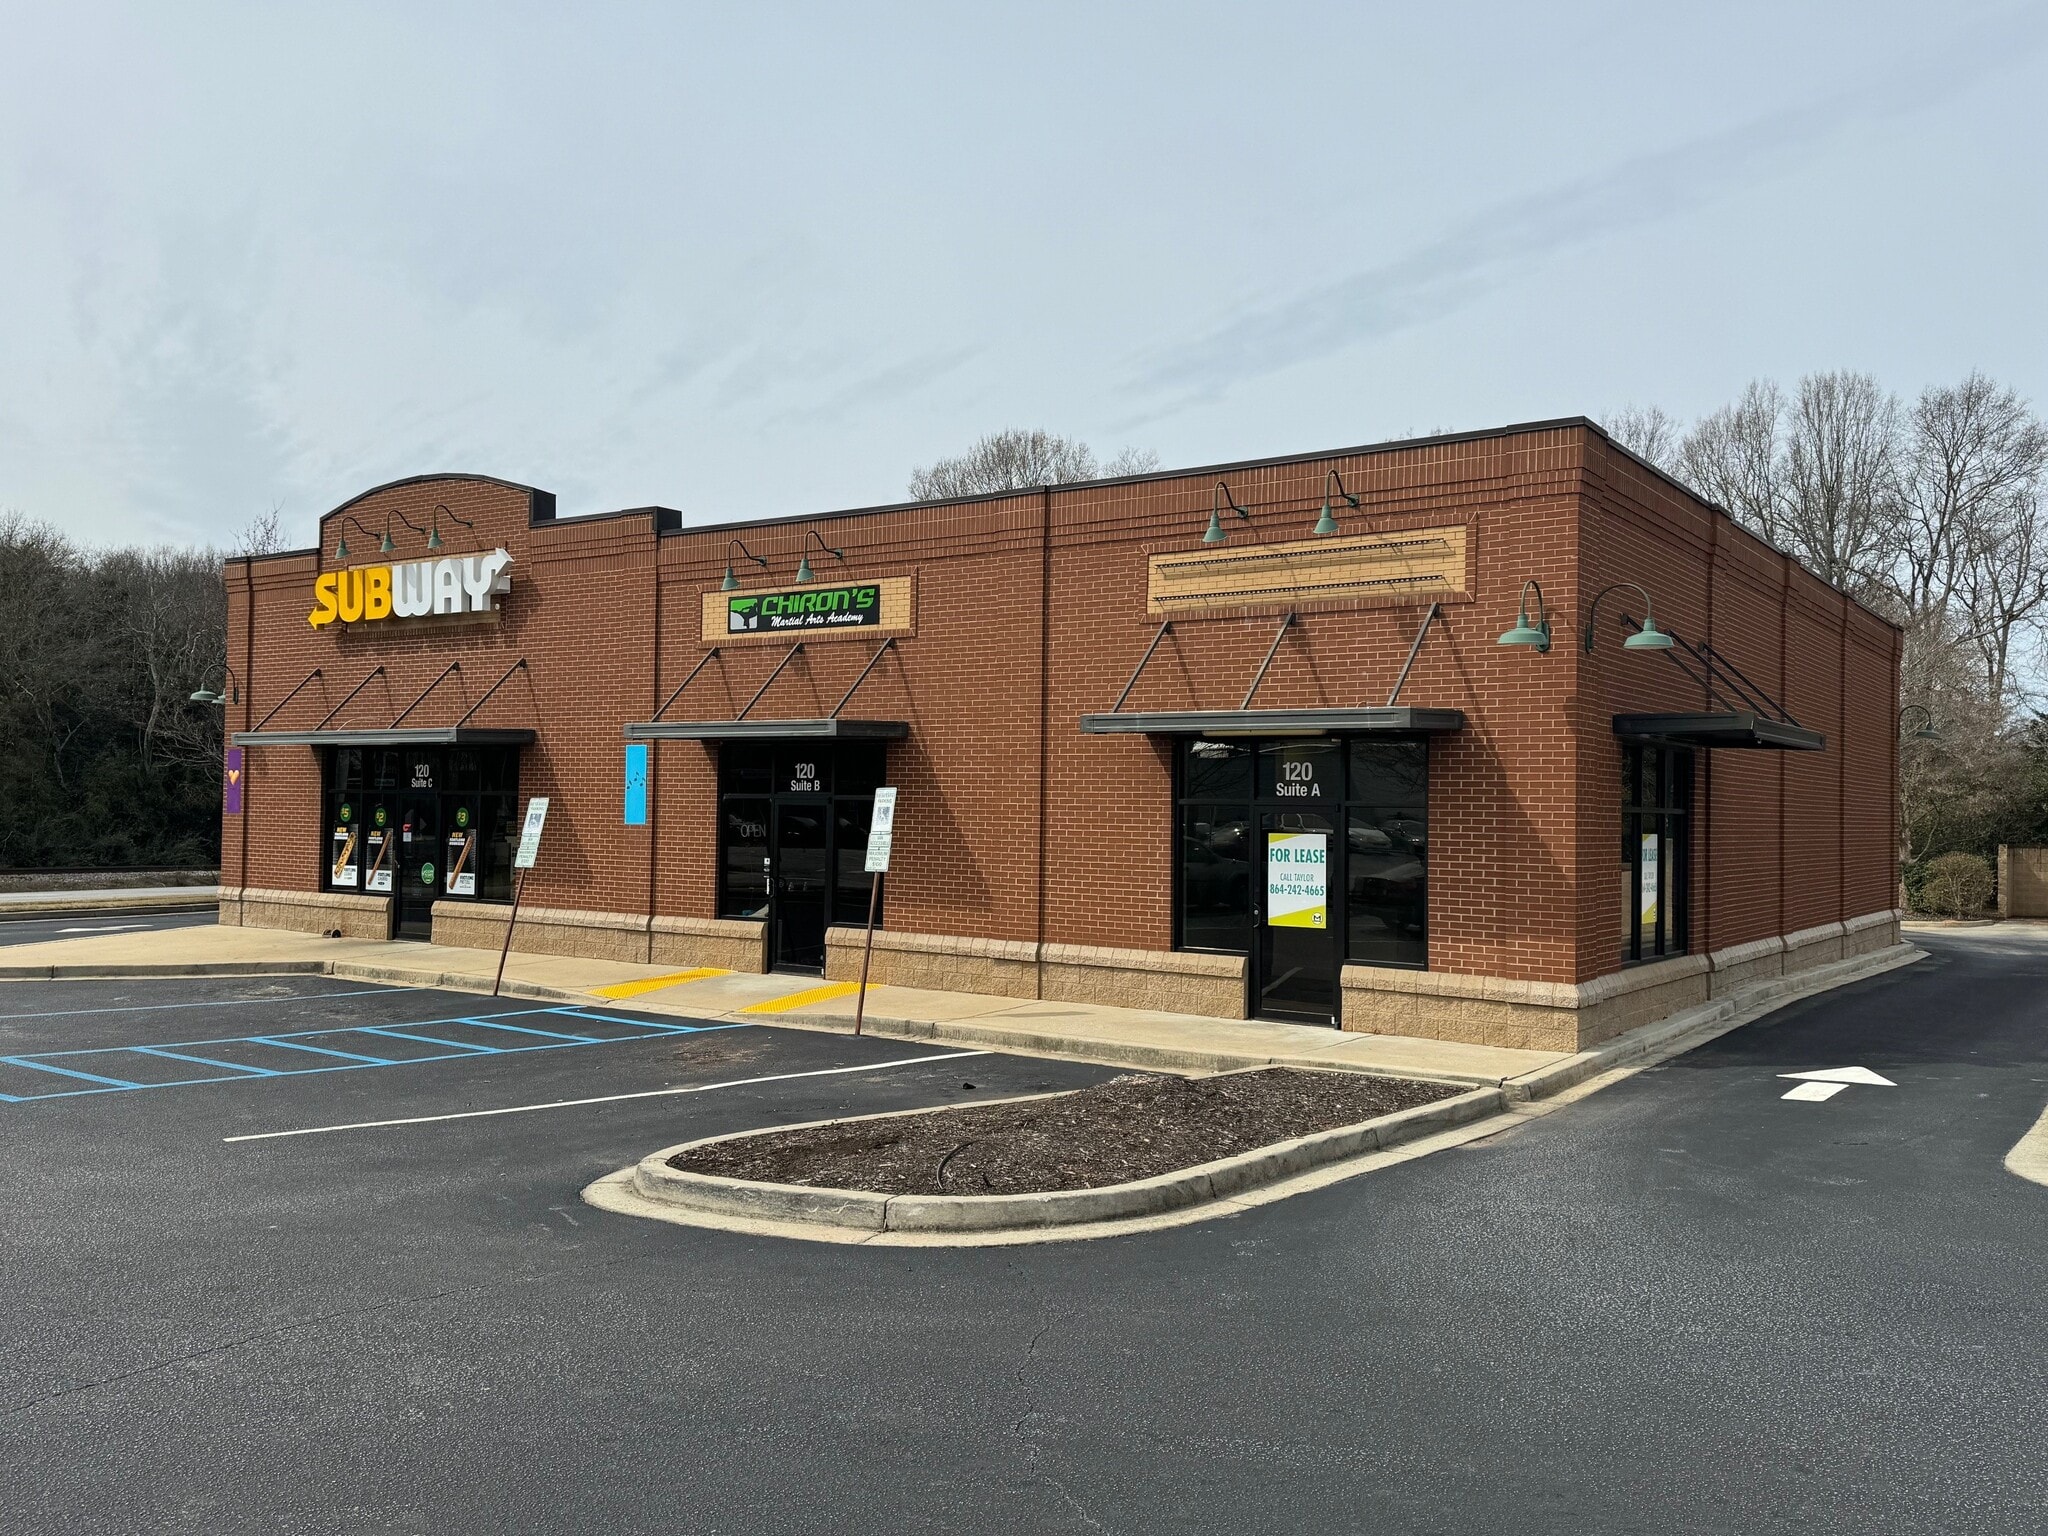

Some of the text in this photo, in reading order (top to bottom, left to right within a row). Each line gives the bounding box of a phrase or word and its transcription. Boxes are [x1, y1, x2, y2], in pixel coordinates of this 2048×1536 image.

[307, 547, 514, 631] SUBWAY
[761, 588, 876, 616] CHIRON'S
[770, 610, 864, 628] Martial Arts Academy
[414, 763, 430, 778] 120
[794, 763, 815, 779] 120
[1282, 761, 1313, 781] 120
[411, 777, 433, 789] Suite C
[790, 779, 820, 791] Suite B
[1275, 783, 1321, 797] Suite A
[376, 812, 384, 822] $2
[457, 811, 466, 822] $3
[740, 823, 767, 838] OPEN
[1269, 847, 1325, 864] FOR LEASE
[1279, 872, 1315, 883] CALL TAYLOR
[1269, 883, 1325, 897] 864-242-4665
